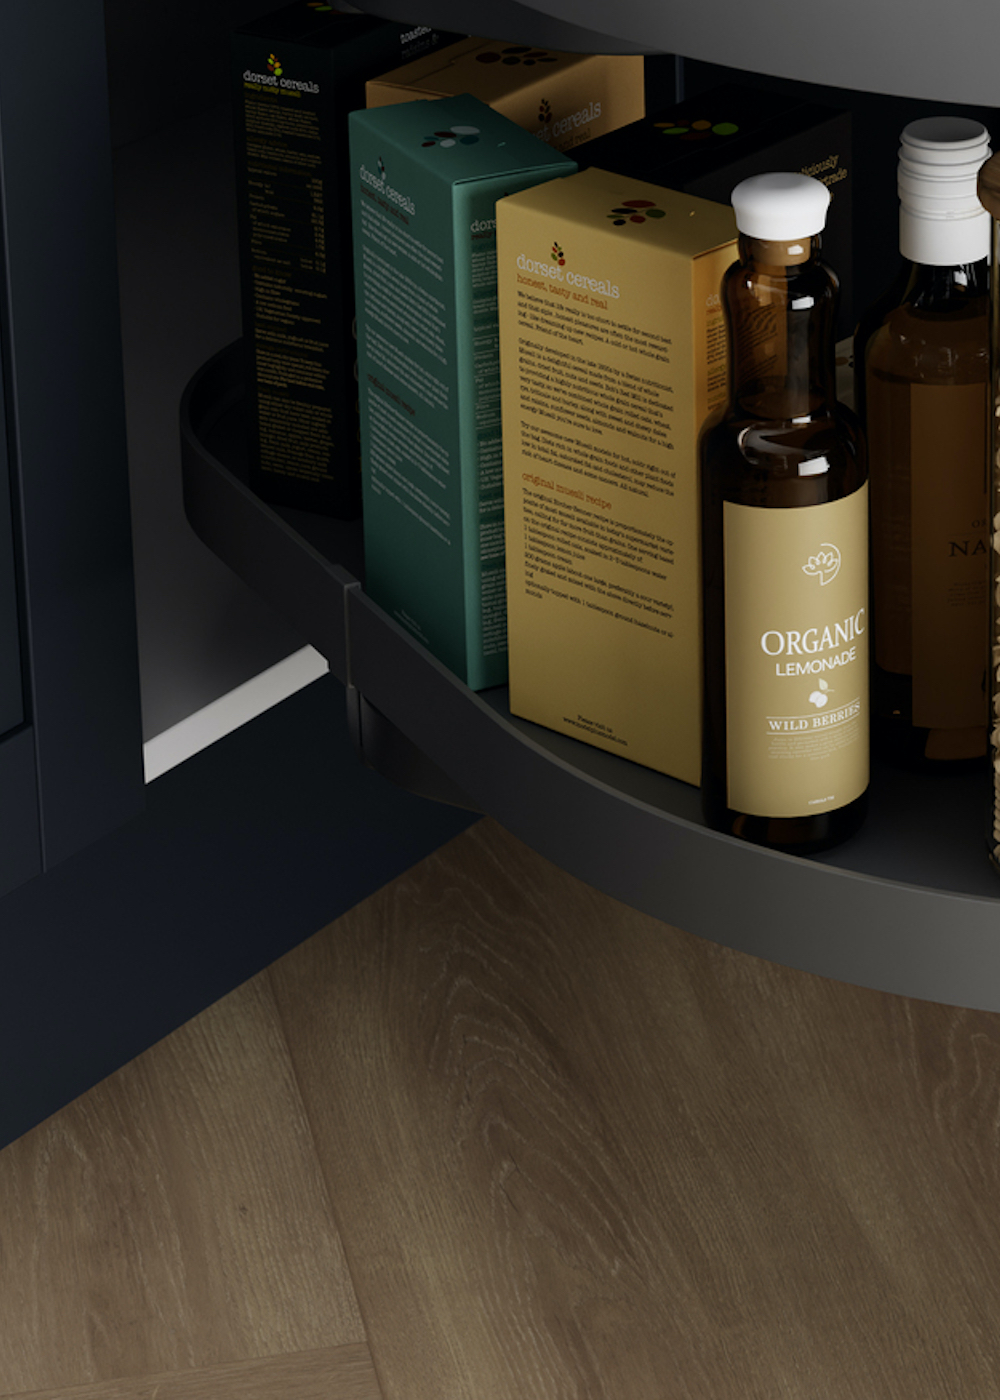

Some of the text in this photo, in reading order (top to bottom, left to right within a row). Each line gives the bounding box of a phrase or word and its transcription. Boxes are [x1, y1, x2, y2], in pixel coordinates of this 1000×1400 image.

[552, 101, 602, 138] cereals
[516, 253, 620, 299] dorset cereals
[761, 607, 866, 656] ORGANIC
[775, 646, 857, 677] LEMONADE
[768, 700, 861, 732] WILD BERRIES
